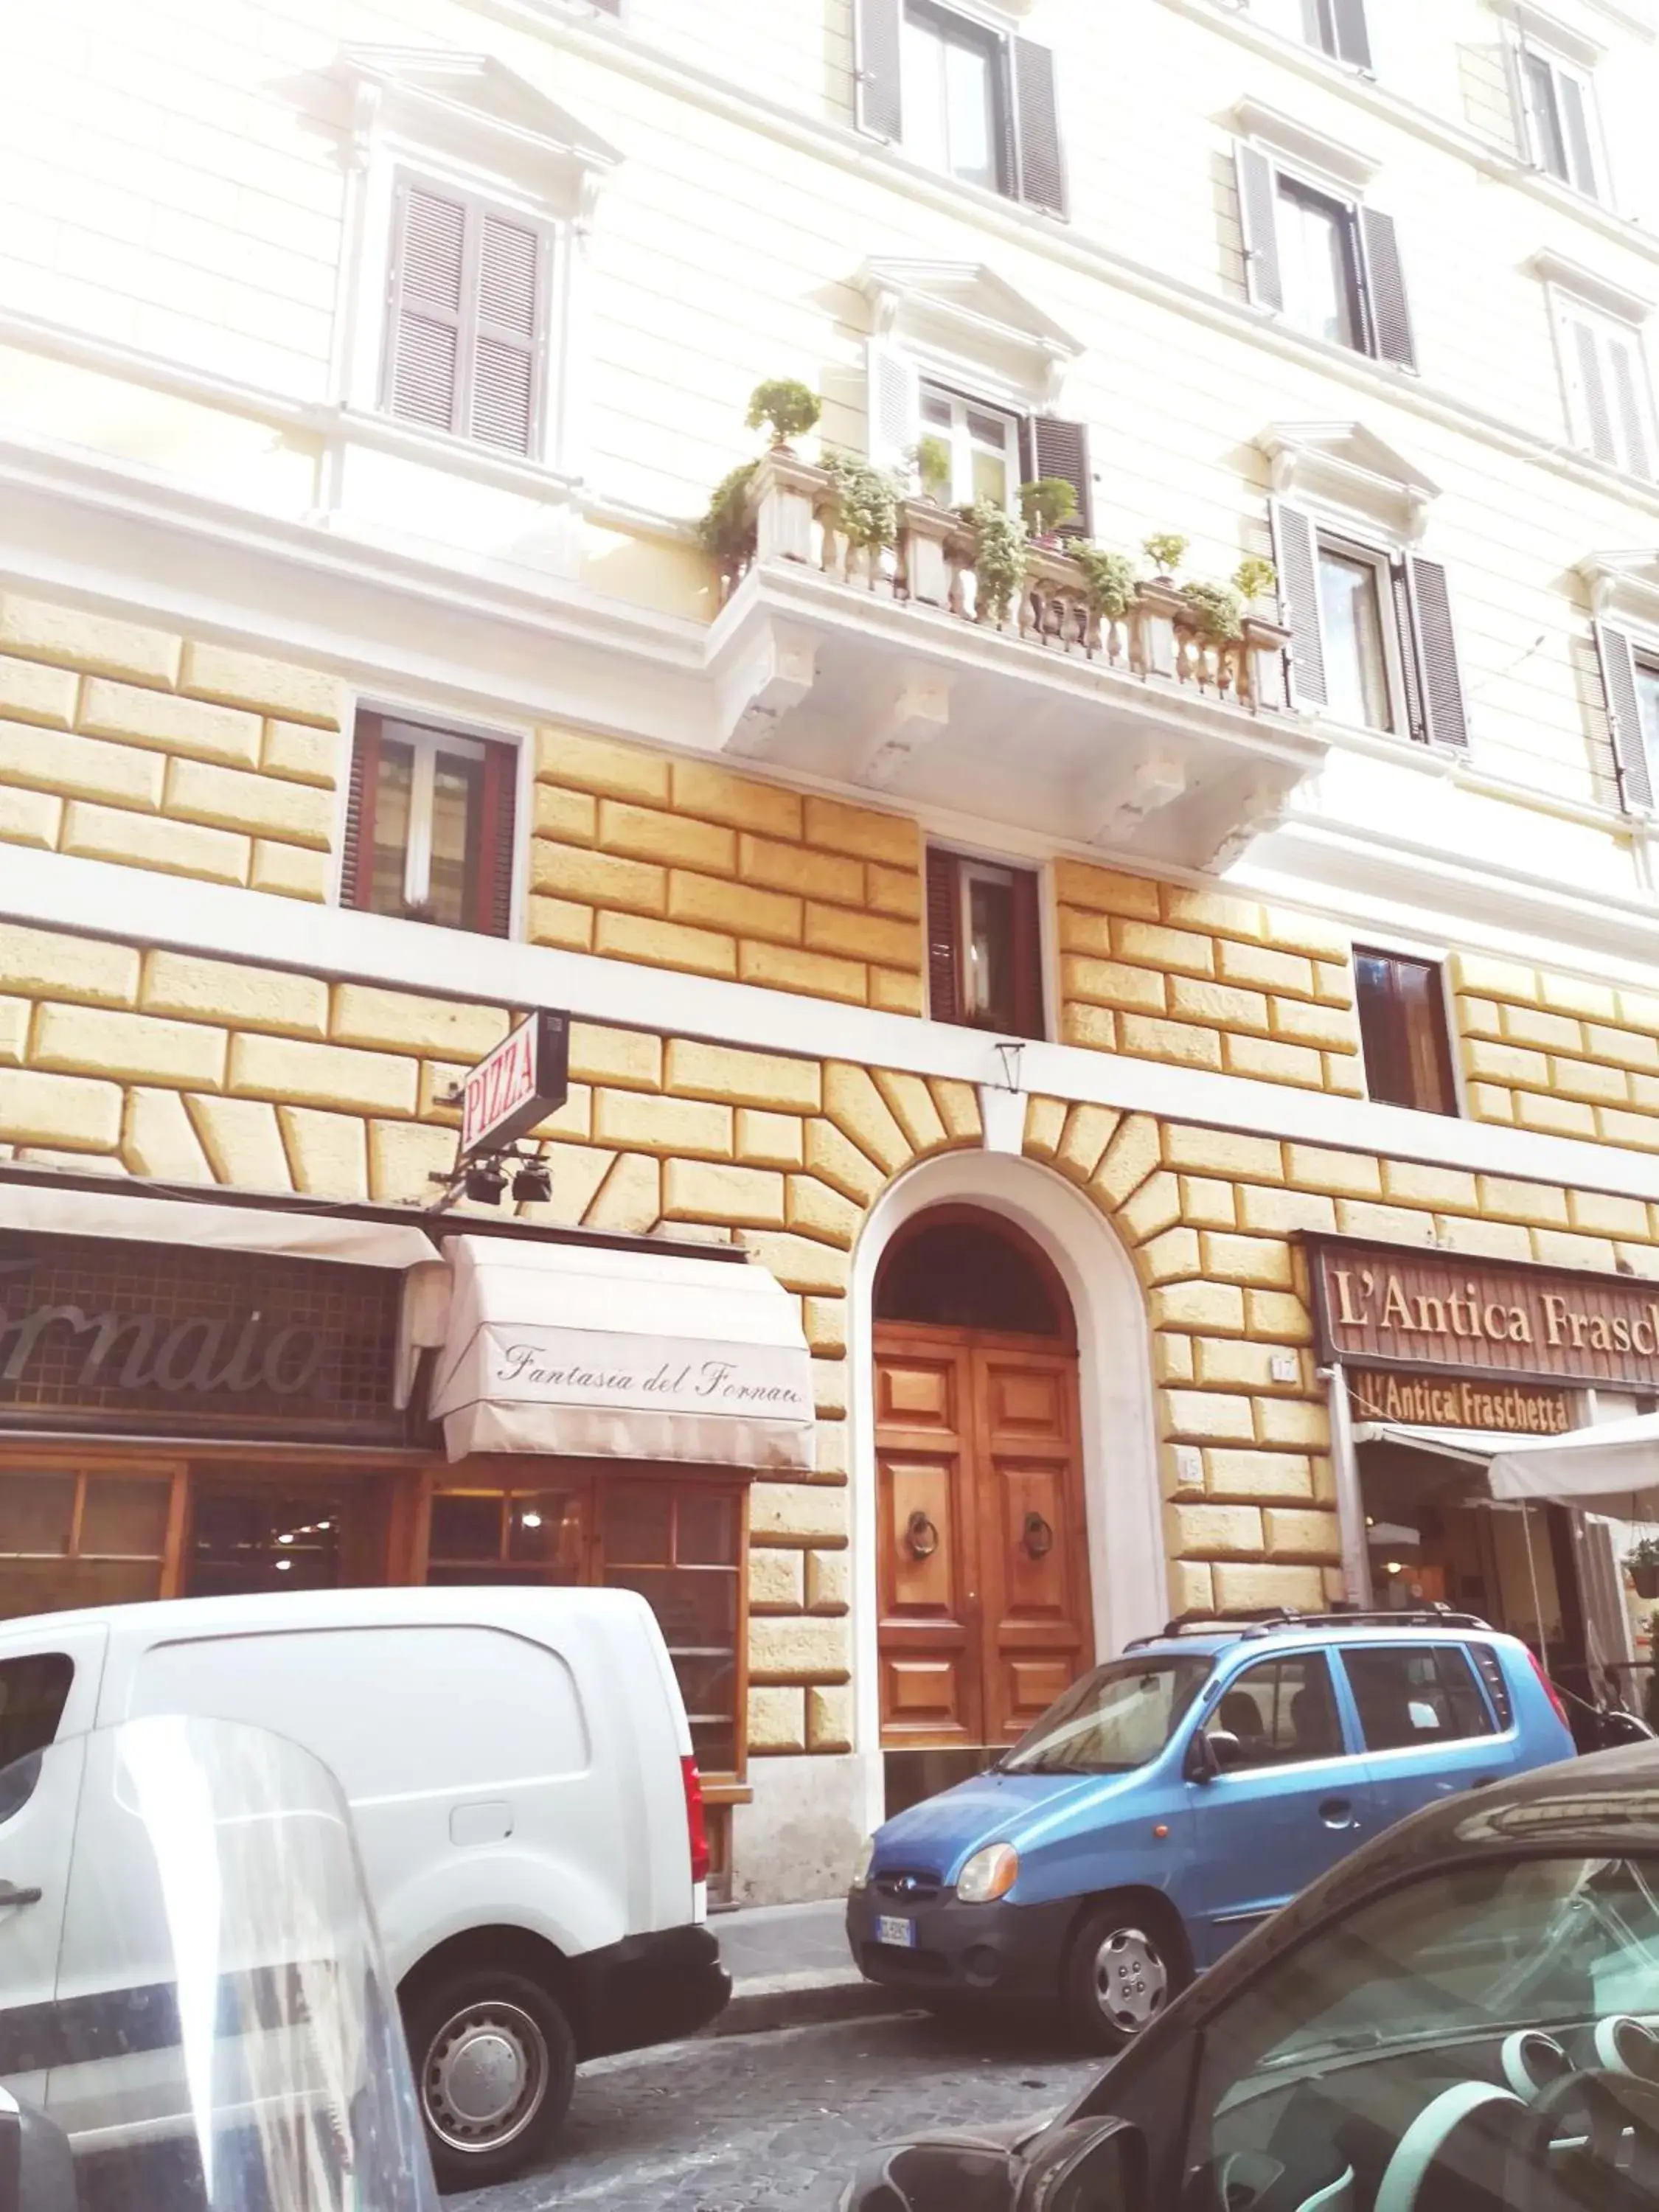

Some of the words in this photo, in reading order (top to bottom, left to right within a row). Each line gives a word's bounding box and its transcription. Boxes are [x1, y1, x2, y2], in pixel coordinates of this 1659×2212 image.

[465, 1031, 534, 1144] PIZZA
[0, 1259, 326, 1394] rnaio
[1332, 1270, 1534, 1344] L'Antica
[497, 1343, 634, 1391] Fantasia
[642, 1362, 692, 1394] del
[1278, 1360, 1292, 1377] 17
[1357, 1373, 1459, 1423] L'Antica
[1461, 1382, 1569, 1433] Fraschetta
